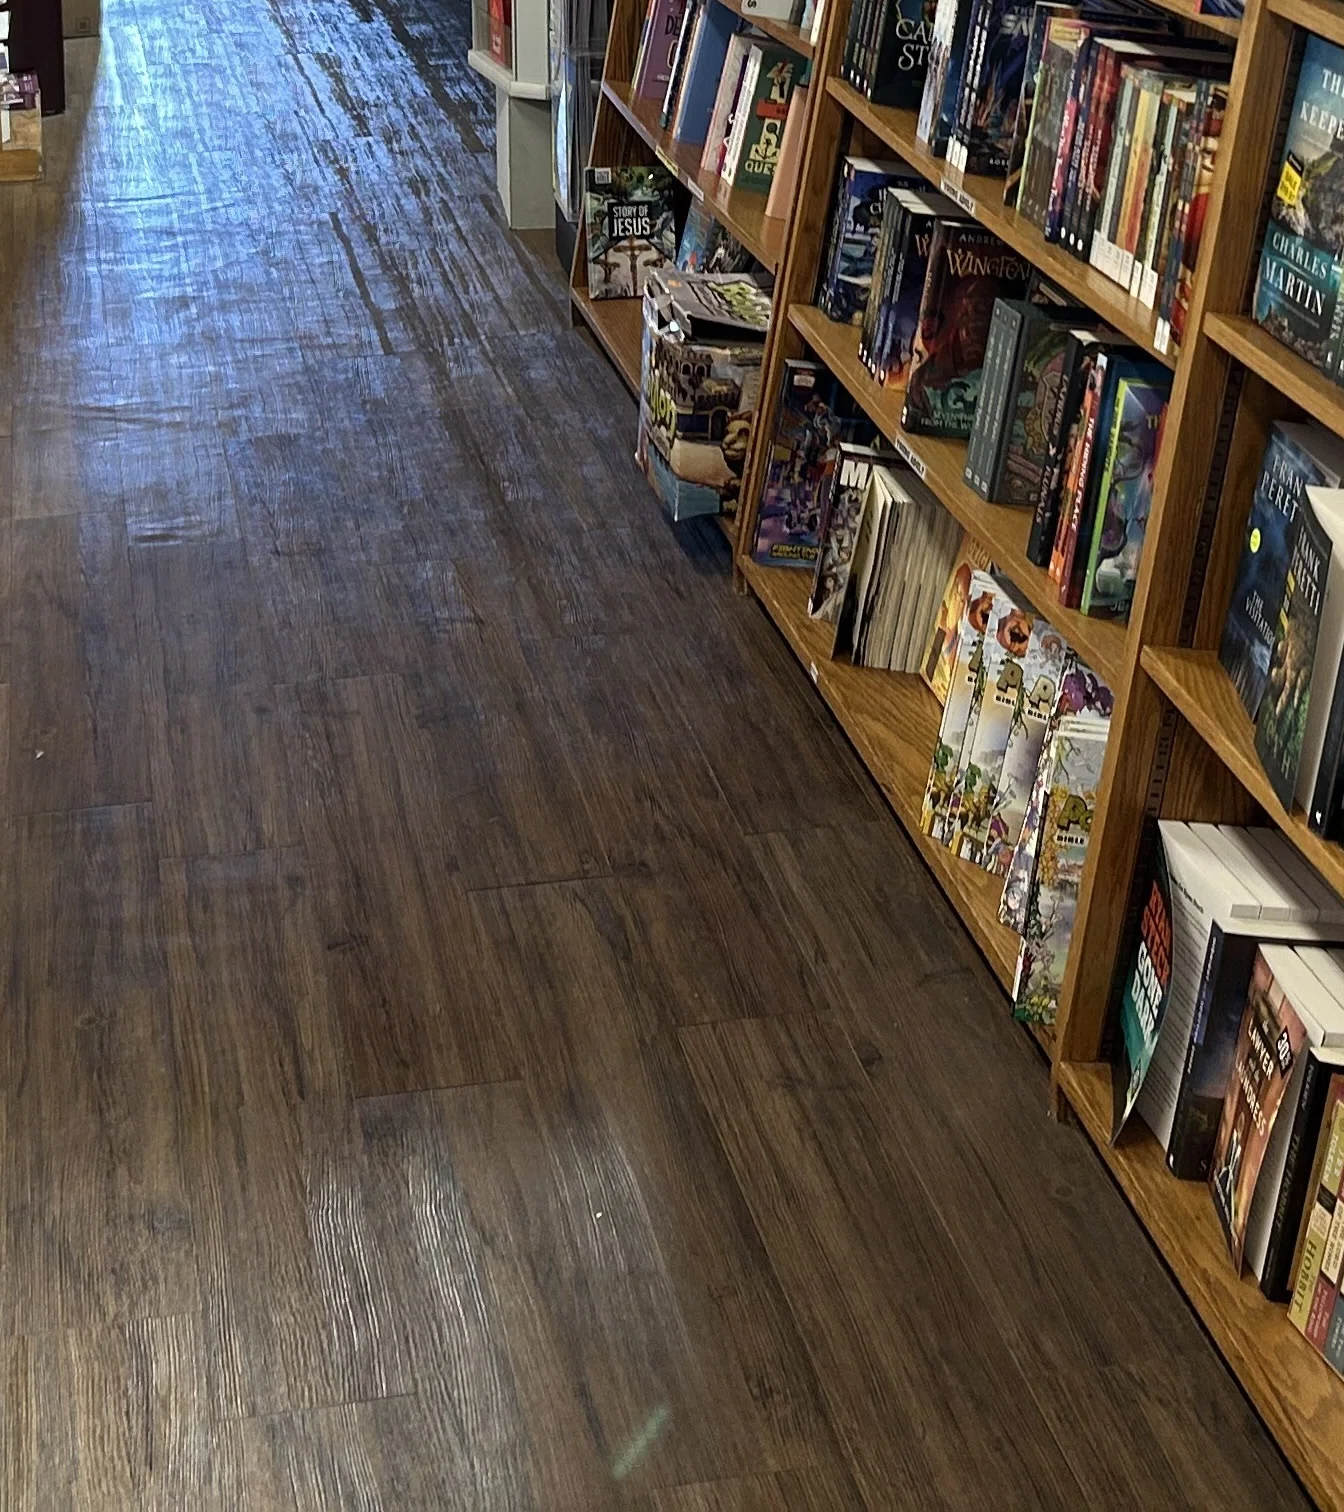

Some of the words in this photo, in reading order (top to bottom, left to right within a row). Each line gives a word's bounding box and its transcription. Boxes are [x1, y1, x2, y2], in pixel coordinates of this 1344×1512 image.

[612, 205, 634, 219] STORY
[635, 205, 648, 216] OF
[612, 217, 651, 237] JESUS
[1272, 230, 1329, 281] CHARLES
[1264, 256, 1324, 316] MARTIN
